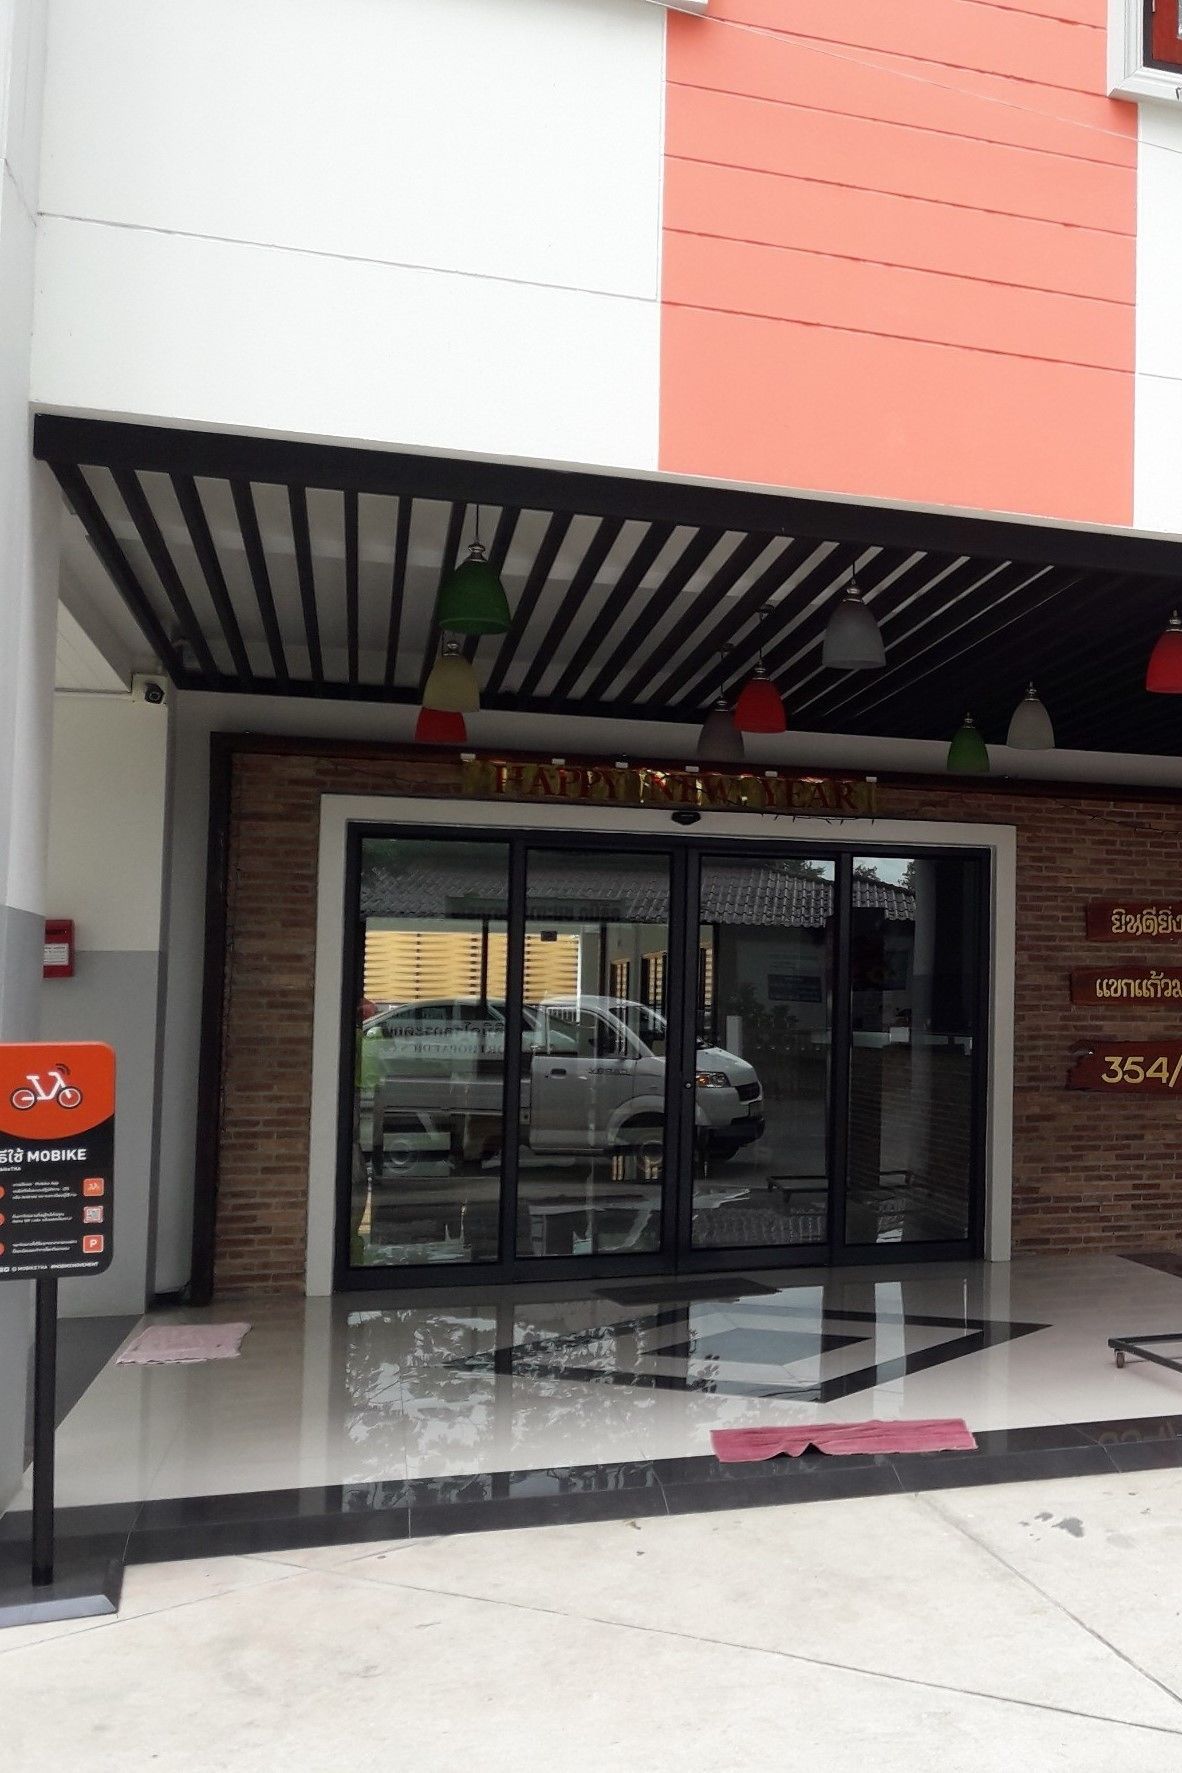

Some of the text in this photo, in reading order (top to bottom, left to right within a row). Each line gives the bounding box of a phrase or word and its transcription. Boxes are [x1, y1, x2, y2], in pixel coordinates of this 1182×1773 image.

[494, 763, 619, 800] HAPPY
[759, 774, 860, 811] YEAR
[27, 1148, 87, 1163] MOBIKE
